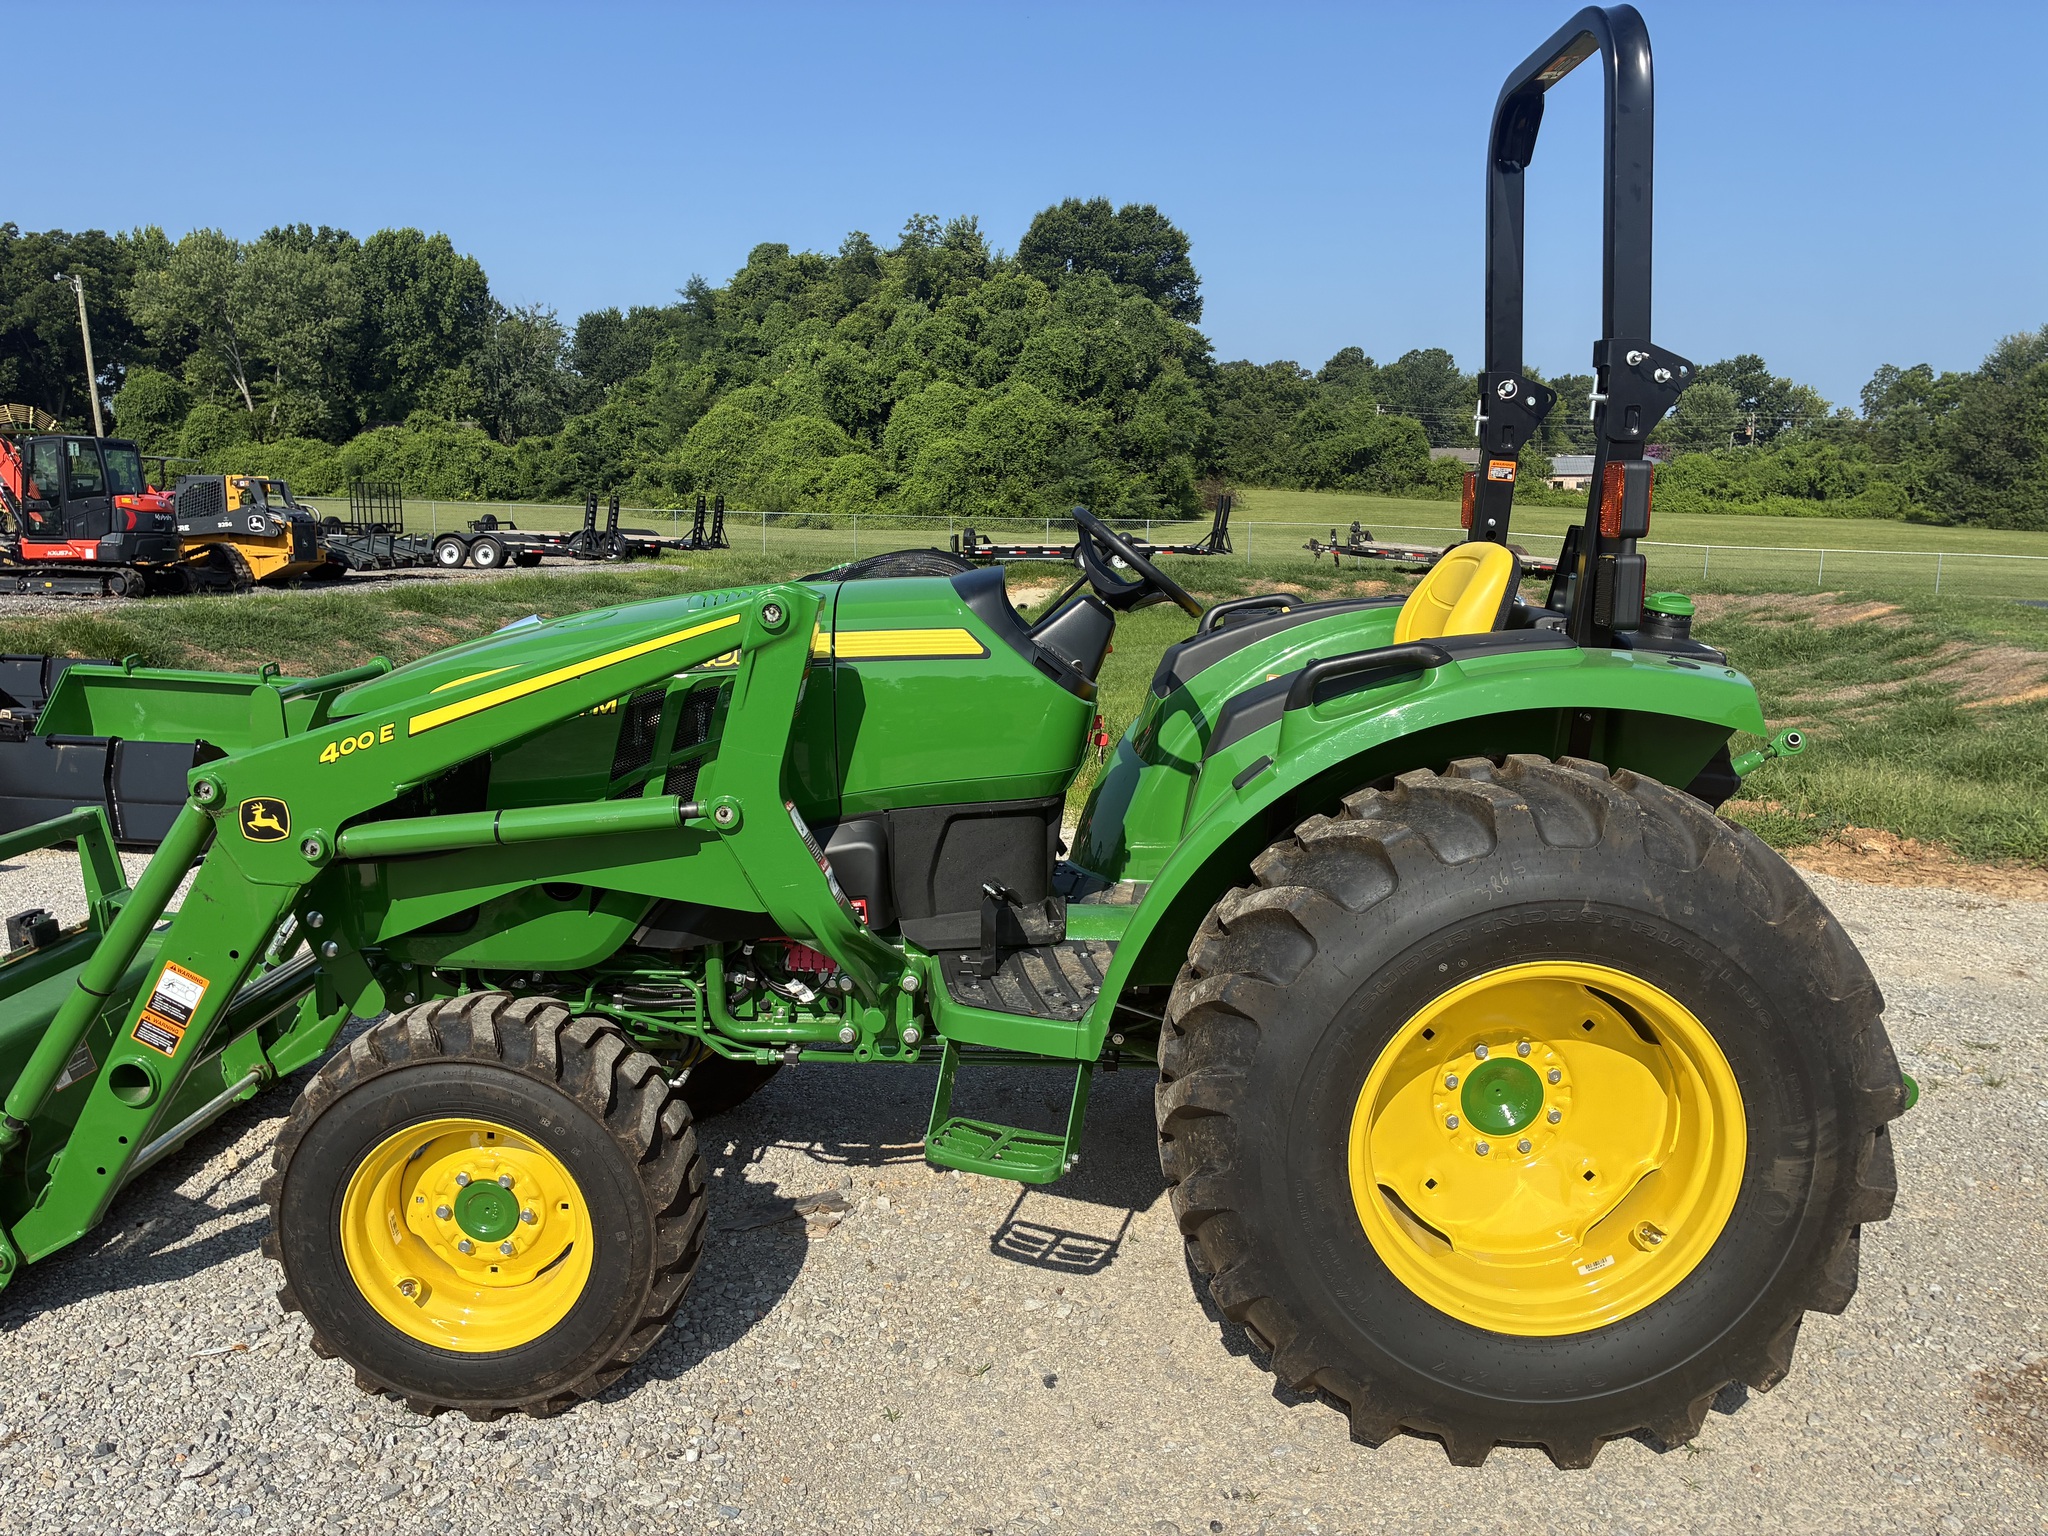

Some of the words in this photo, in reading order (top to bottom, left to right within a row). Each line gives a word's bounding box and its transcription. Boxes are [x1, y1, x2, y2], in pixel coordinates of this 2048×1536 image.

[177, 967, 204, 985] WARNING
[1357, 928, 1471, 1012] SUPER
[1481, 909, 1711, 971] INDUSTRIAL
[1719, 969, 1776, 1030] LUG
[153, 1017, 180, 1035] WARNING
